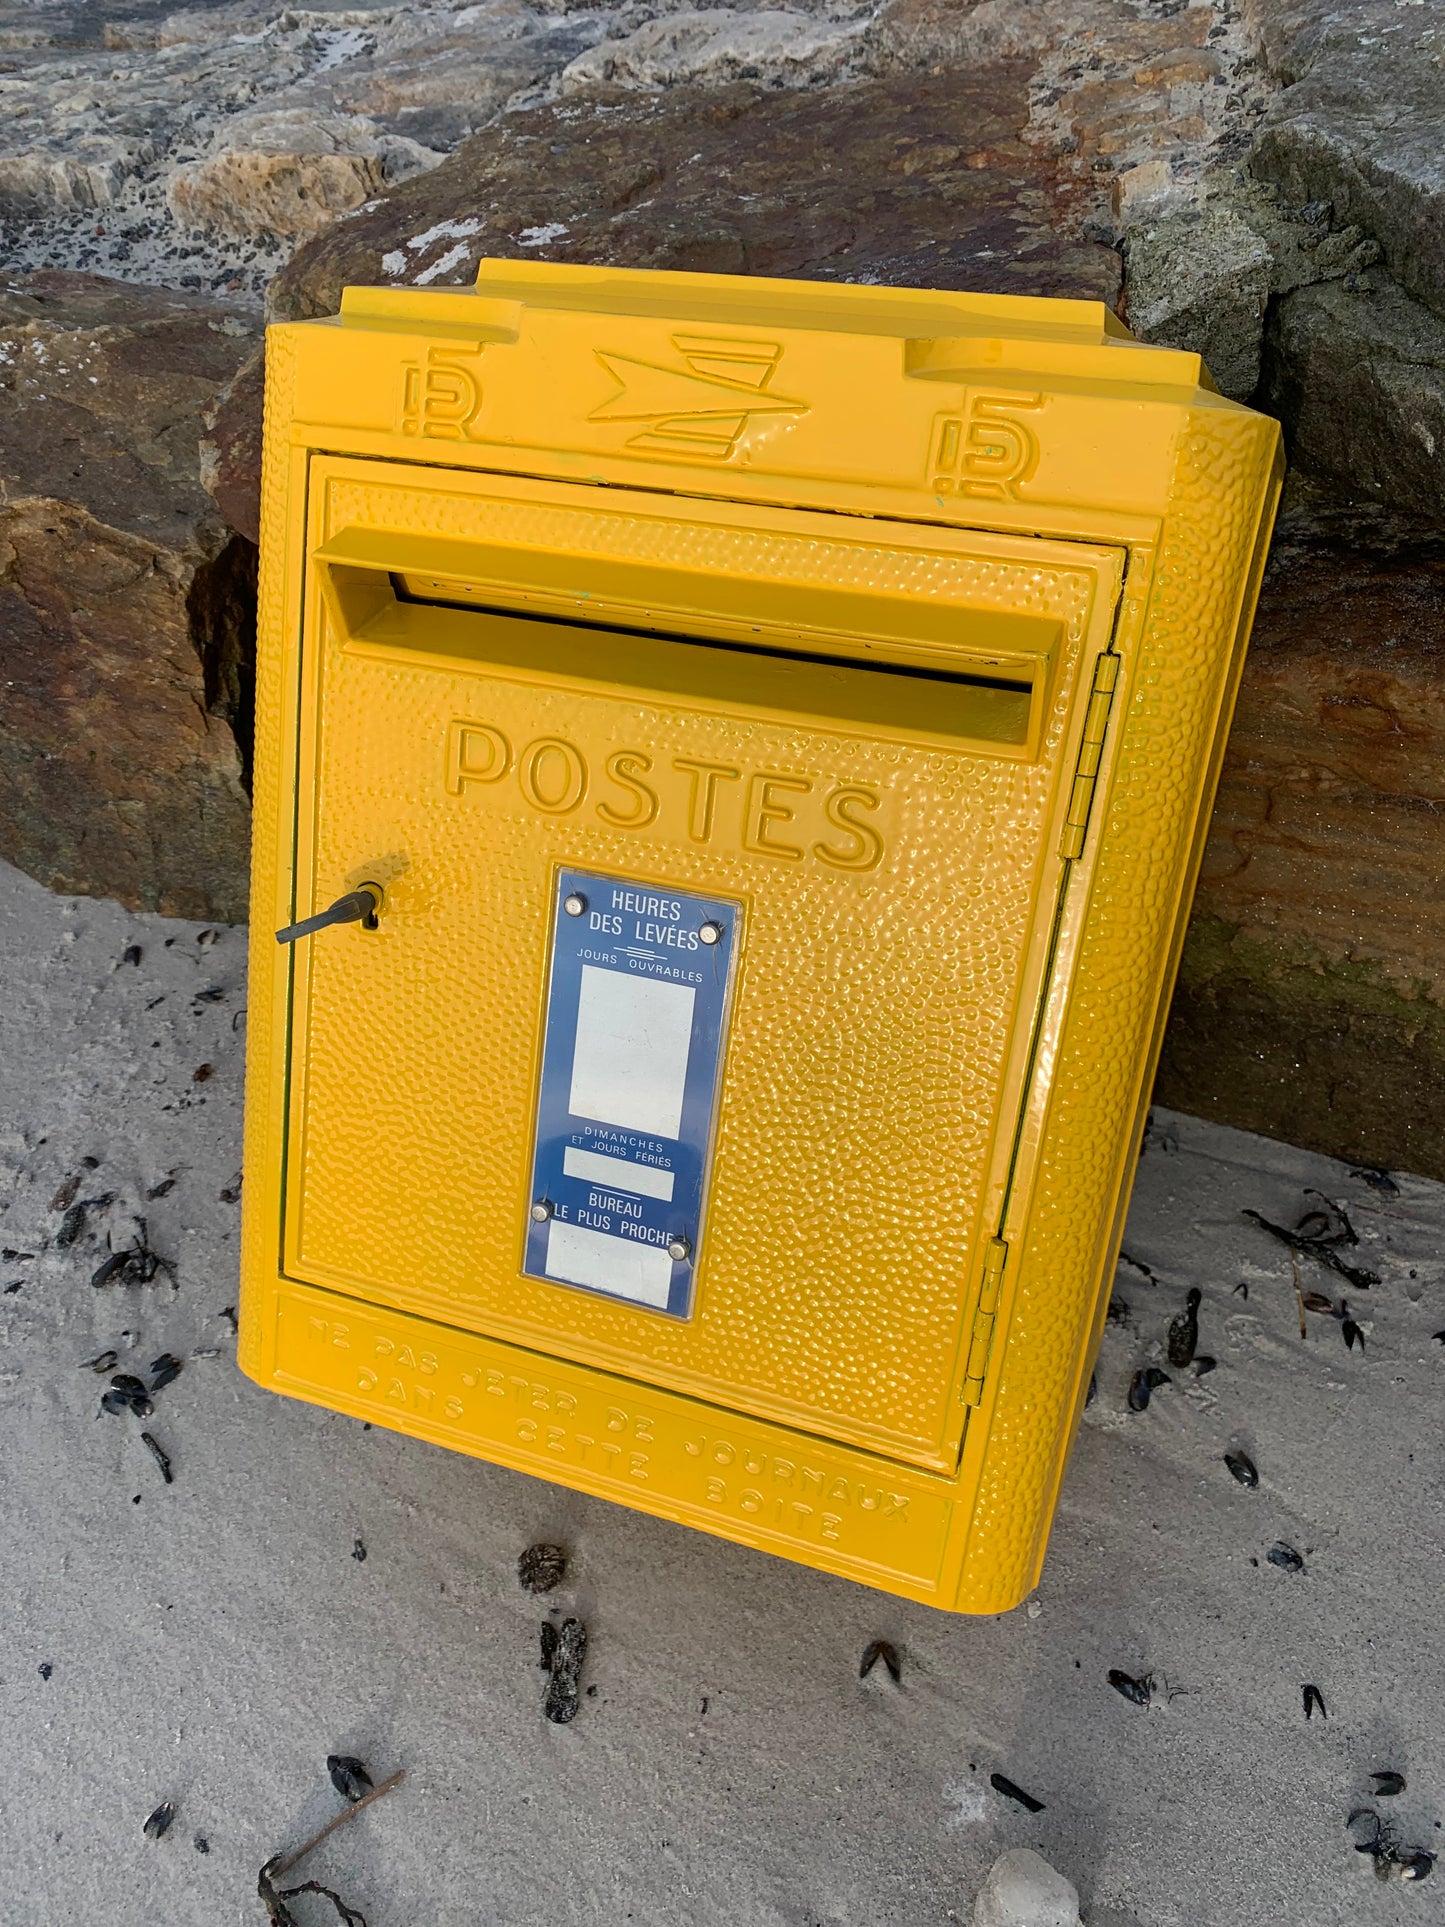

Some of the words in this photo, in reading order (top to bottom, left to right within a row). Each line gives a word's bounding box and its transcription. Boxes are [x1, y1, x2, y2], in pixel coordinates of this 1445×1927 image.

[445, 719, 884, 872] POSTES
[611, 889, 682, 921] HEURES
[589, 911, 623, 935] DES
[635, 920, 699, 951] LEVÉES
[576, 948, 618, 964] JOURS
[629, 959, 704, 983] OUVRABLES
[571, 1136, 584, 1145] ET
[591, 1140, 627, 1156] JOURS
[635, 1150, 672, 1168] FÉRIÉS
[584, 1126, 664, 1153] DIMANCHES
[588, 1192, 643, 1218] BUREAU
[554, 1203, 569, 1219] LE
[578, 1209, 611, 1230] PLUS
[620, 1221, 674, 1247] PROCHE
[308, 1315, 351, 1349] NE
[375, 1335, 439, 1375] PAS
[461, 1366, 578, 1417] JETER
[606, 1406, 655, 1443] DE
[683, 1435, 911, 1523] JOURNAUX
[356, 1365, 464, 1420] DANS
[516, 1416, 649, 1481] CETTE
[705, 1475, 843, 1541] BOITE
